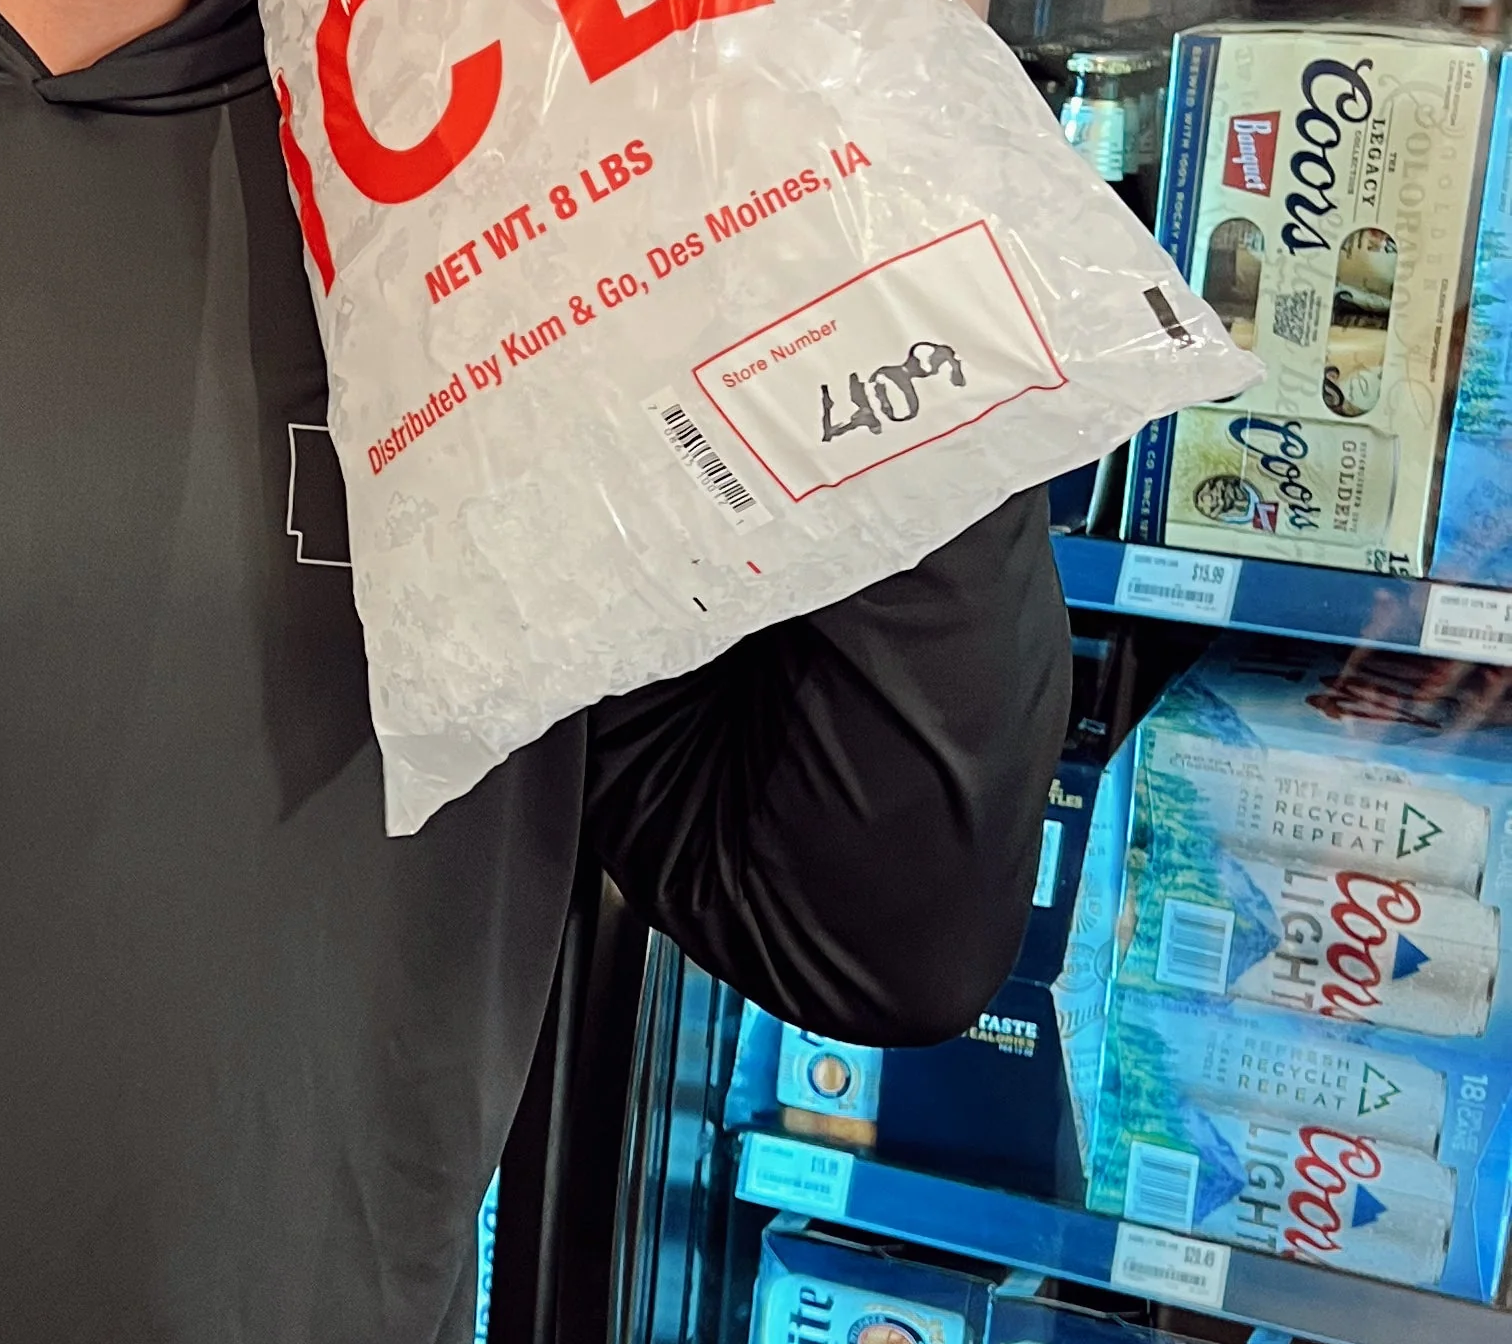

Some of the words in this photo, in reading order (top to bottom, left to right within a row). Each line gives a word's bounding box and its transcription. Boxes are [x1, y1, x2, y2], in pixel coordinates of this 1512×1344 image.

[1280, 57, 1375, 257] Coors
[1362, 118, 1386, 208] LEGACY
[424, 240, 484, 305] NET
[481, 204, 547, 260] WT.
[548, 184, 578, 221] 8
[579, 138, 654, 204] LBS
[367, 373, 468, 476] Distributed
[465, 354, 504, 391] by
[500, 313, 568, 368] Kum
[568, 295, 597, 327] &
[595, 272, 650, 310] Go,
[646, 231, 706, 281] Des
[704, 166, 832, 245] Moines,
[829, 141, 872, 179] IA
[721, 358, 769, 390] Store
[769, 317, 839, 365] Number
[820, 341, 967, 443] 409
[1229, 416, 1322, 531] Coors
[1333, 440, 1357, 532] GOLDEN
[1271, 820, 1385, 855] REPEAT
[1274, 799, 1388, 834] RECYCLE
[1271, 868, 1328, 1010] LIGHT
[1236, 1074, 1347, 1112] REPEAT
[1241, 1054, 1350, 1091] RECYCLE
[1243, 1035, 1351, 1073] REFRESH
[1459, 1074, 1487, 1103] 18
[1236, 1121, 1292, 1250] LIGHT
